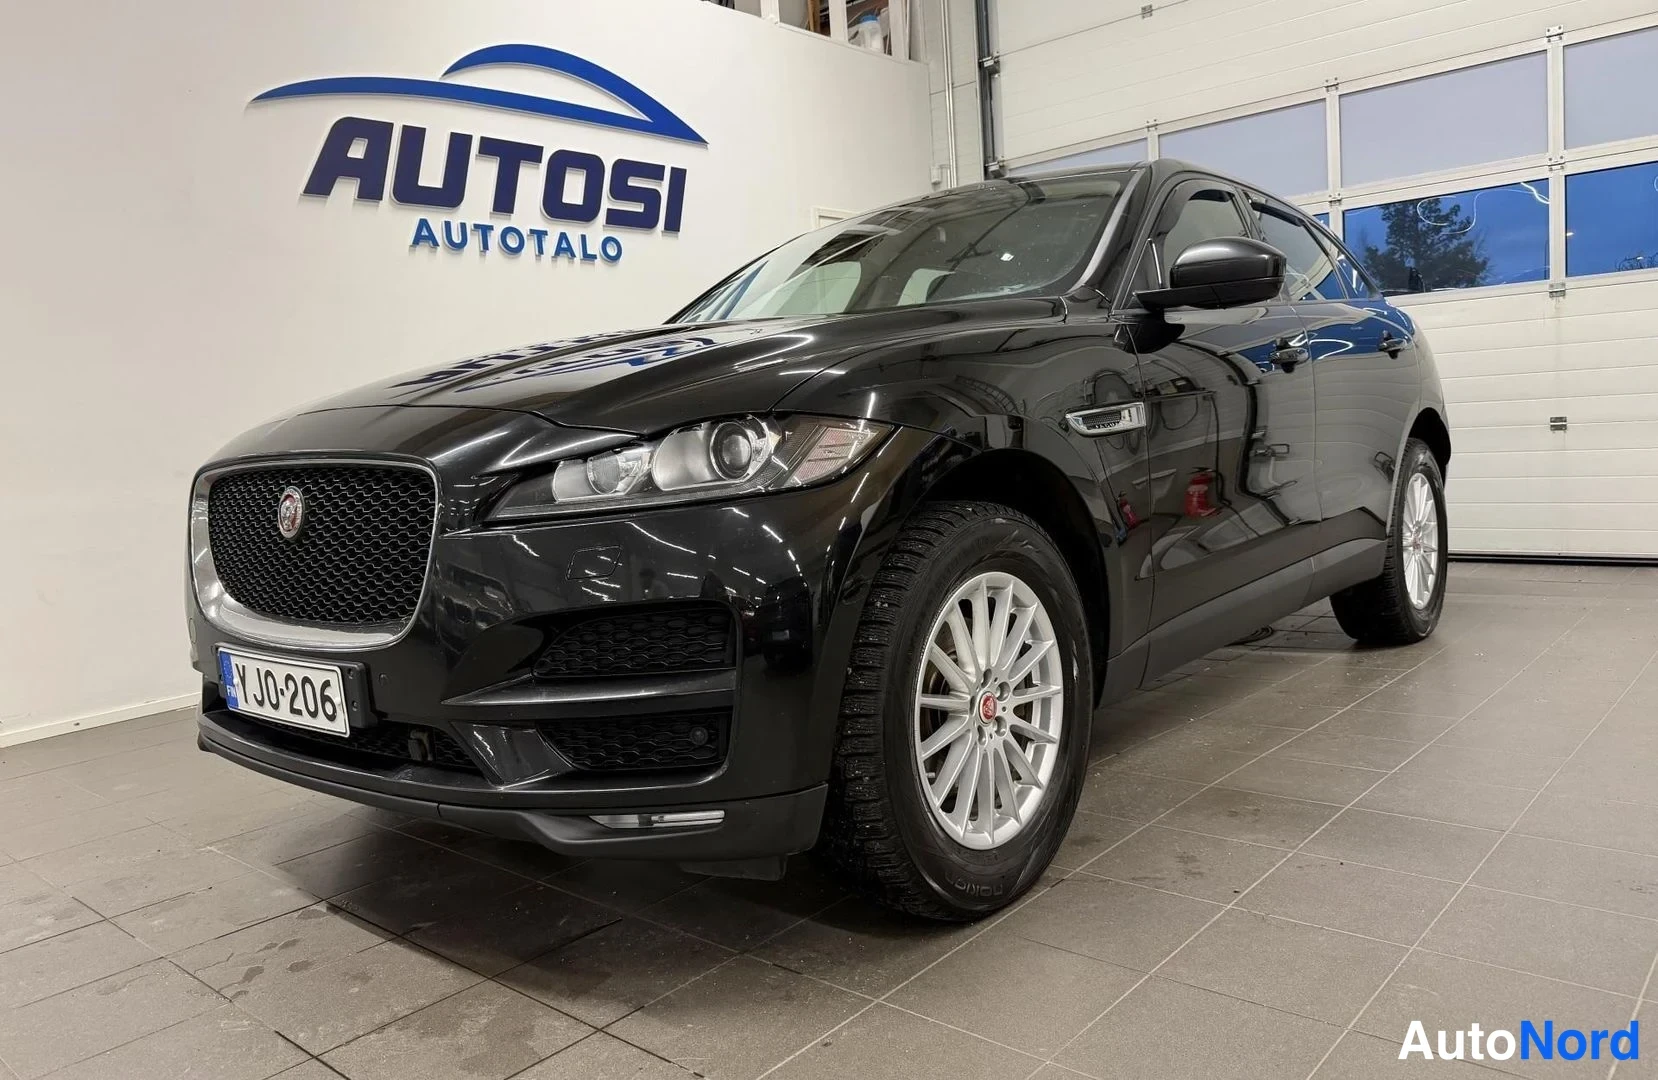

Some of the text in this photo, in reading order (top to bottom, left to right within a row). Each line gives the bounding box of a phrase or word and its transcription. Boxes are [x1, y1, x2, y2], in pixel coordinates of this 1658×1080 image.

[302, 116, 687, 233] AUTOSI
[411, 217, 623, 264] AUTOTALO
[235, 663, 337, 722] YJO-206
